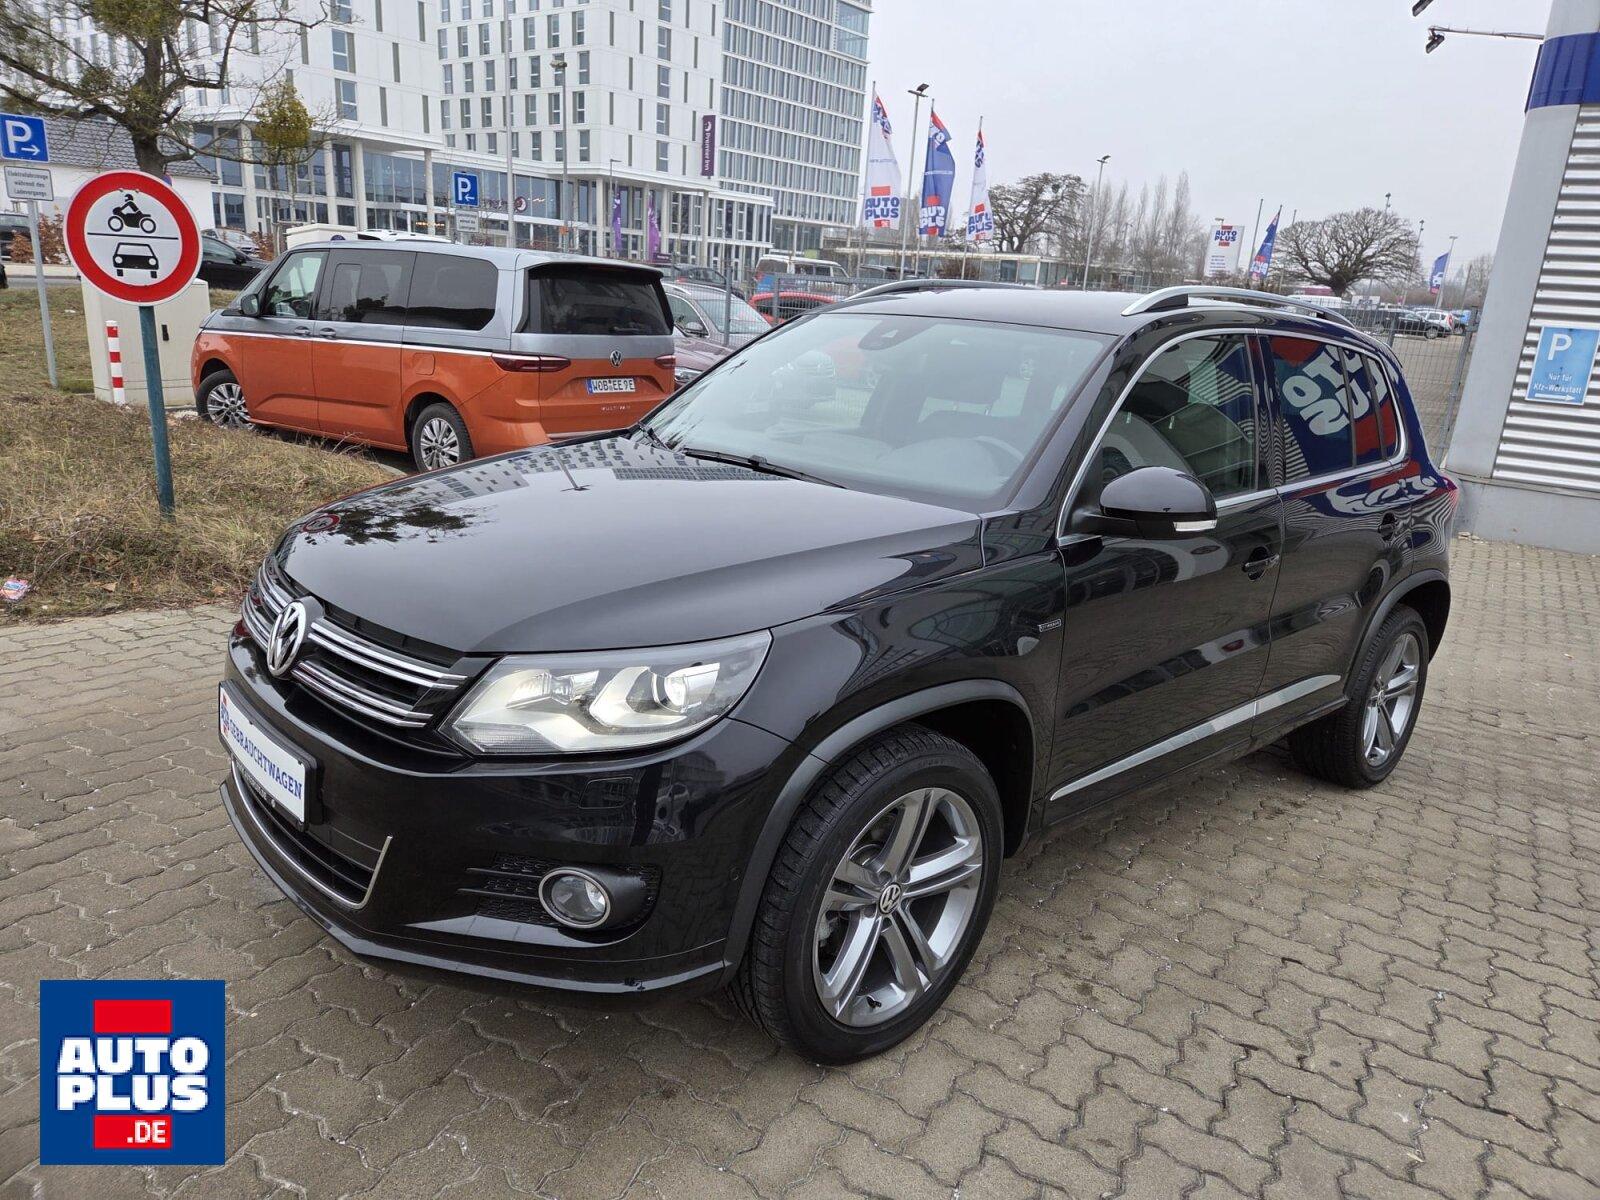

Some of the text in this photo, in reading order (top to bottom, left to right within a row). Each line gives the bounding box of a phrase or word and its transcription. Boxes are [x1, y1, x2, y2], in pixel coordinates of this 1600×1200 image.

[5, 120, 32, 153] P
[457, 177, 472, 201] P
[865, 197, 900, 209] AUTO
[865, 208, 899, 220] PLUS
[1548, 333, 1572, 361] P
[592, 379, 609, 391] WOB
[1548, 372, 1560, 381] Nur
[230, 719, 303, 800] GEBRAUCHTWAGEN
